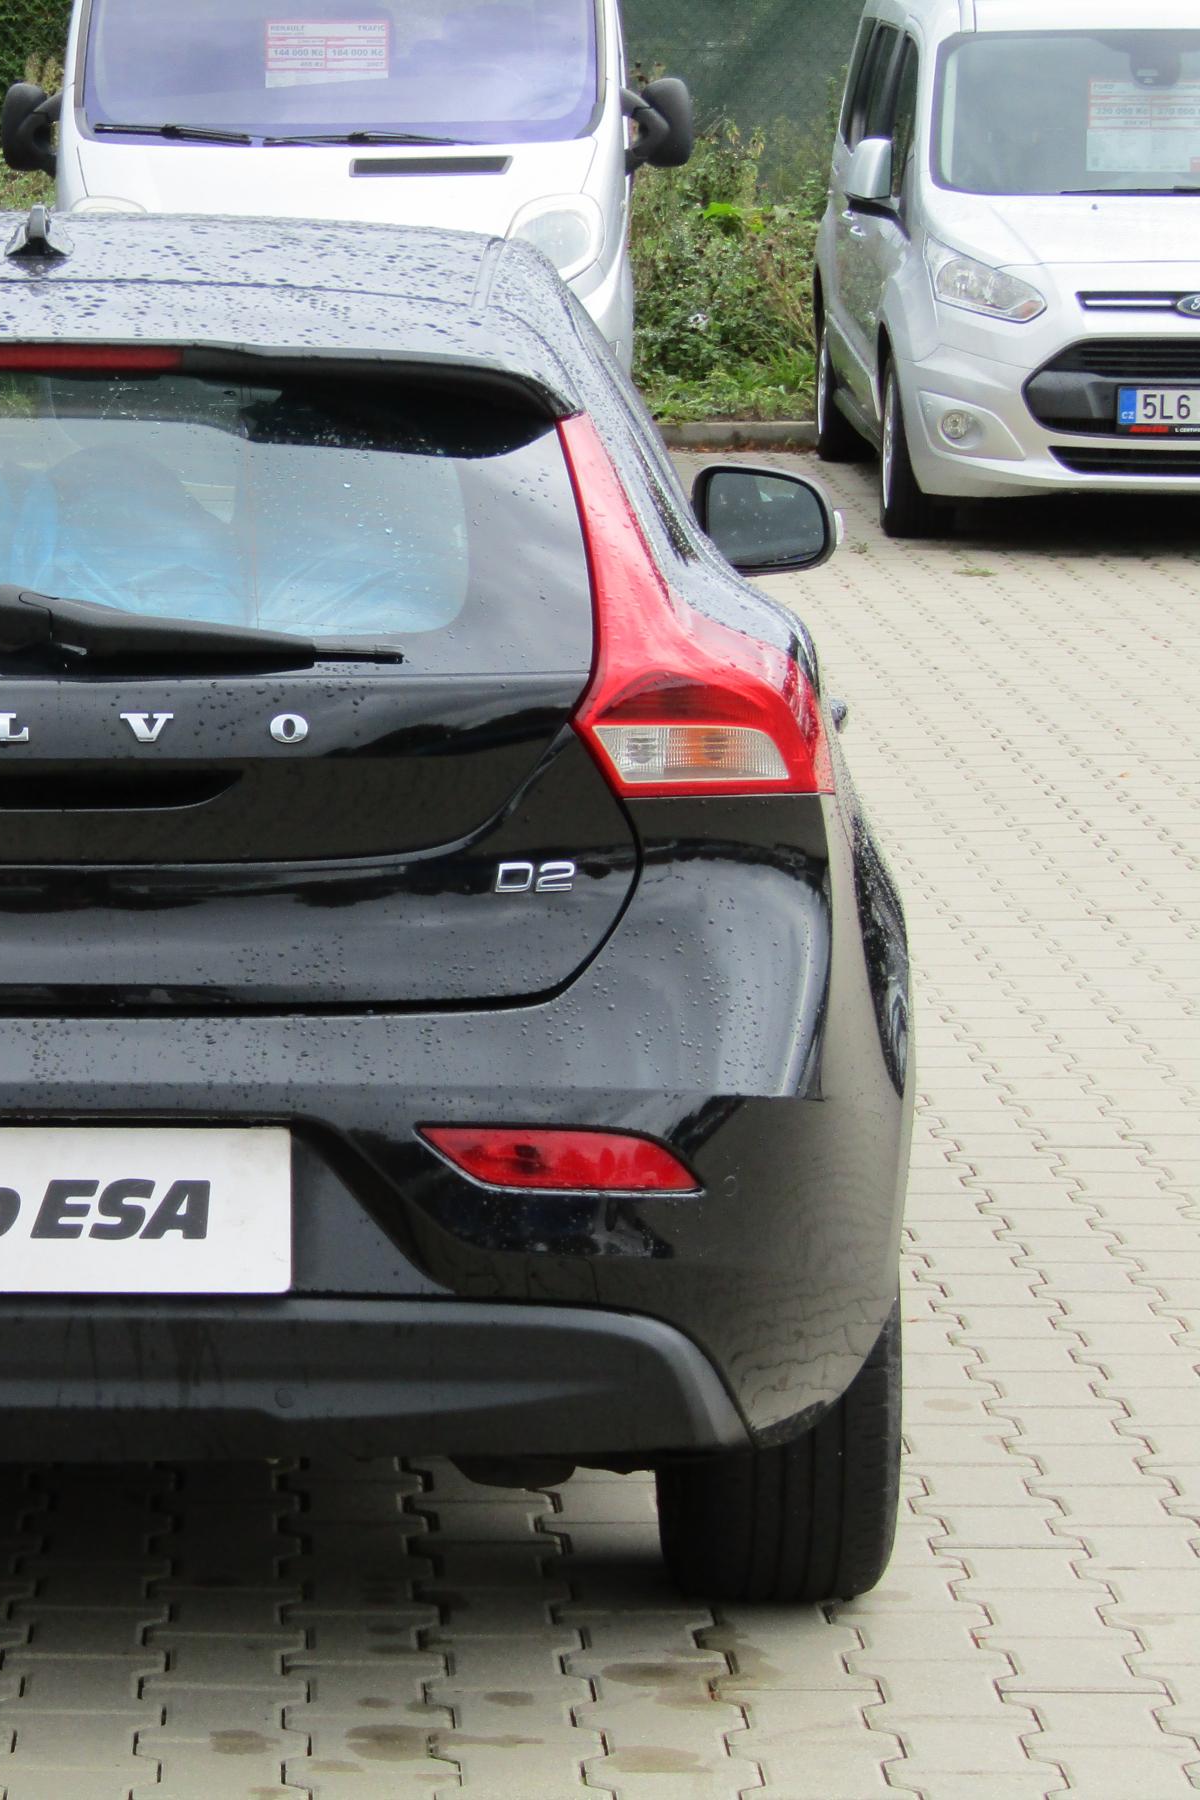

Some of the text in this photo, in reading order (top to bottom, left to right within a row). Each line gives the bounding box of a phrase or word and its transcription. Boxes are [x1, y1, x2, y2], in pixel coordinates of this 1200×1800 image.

[292, 49, 309, 57] 000
[351, 49, 368, 57] 000
[1121, 394, 1191, 420] CZ 5L6
[495, 861, 575, 893] D2
[30, 1179, 212, 1241] ESA
